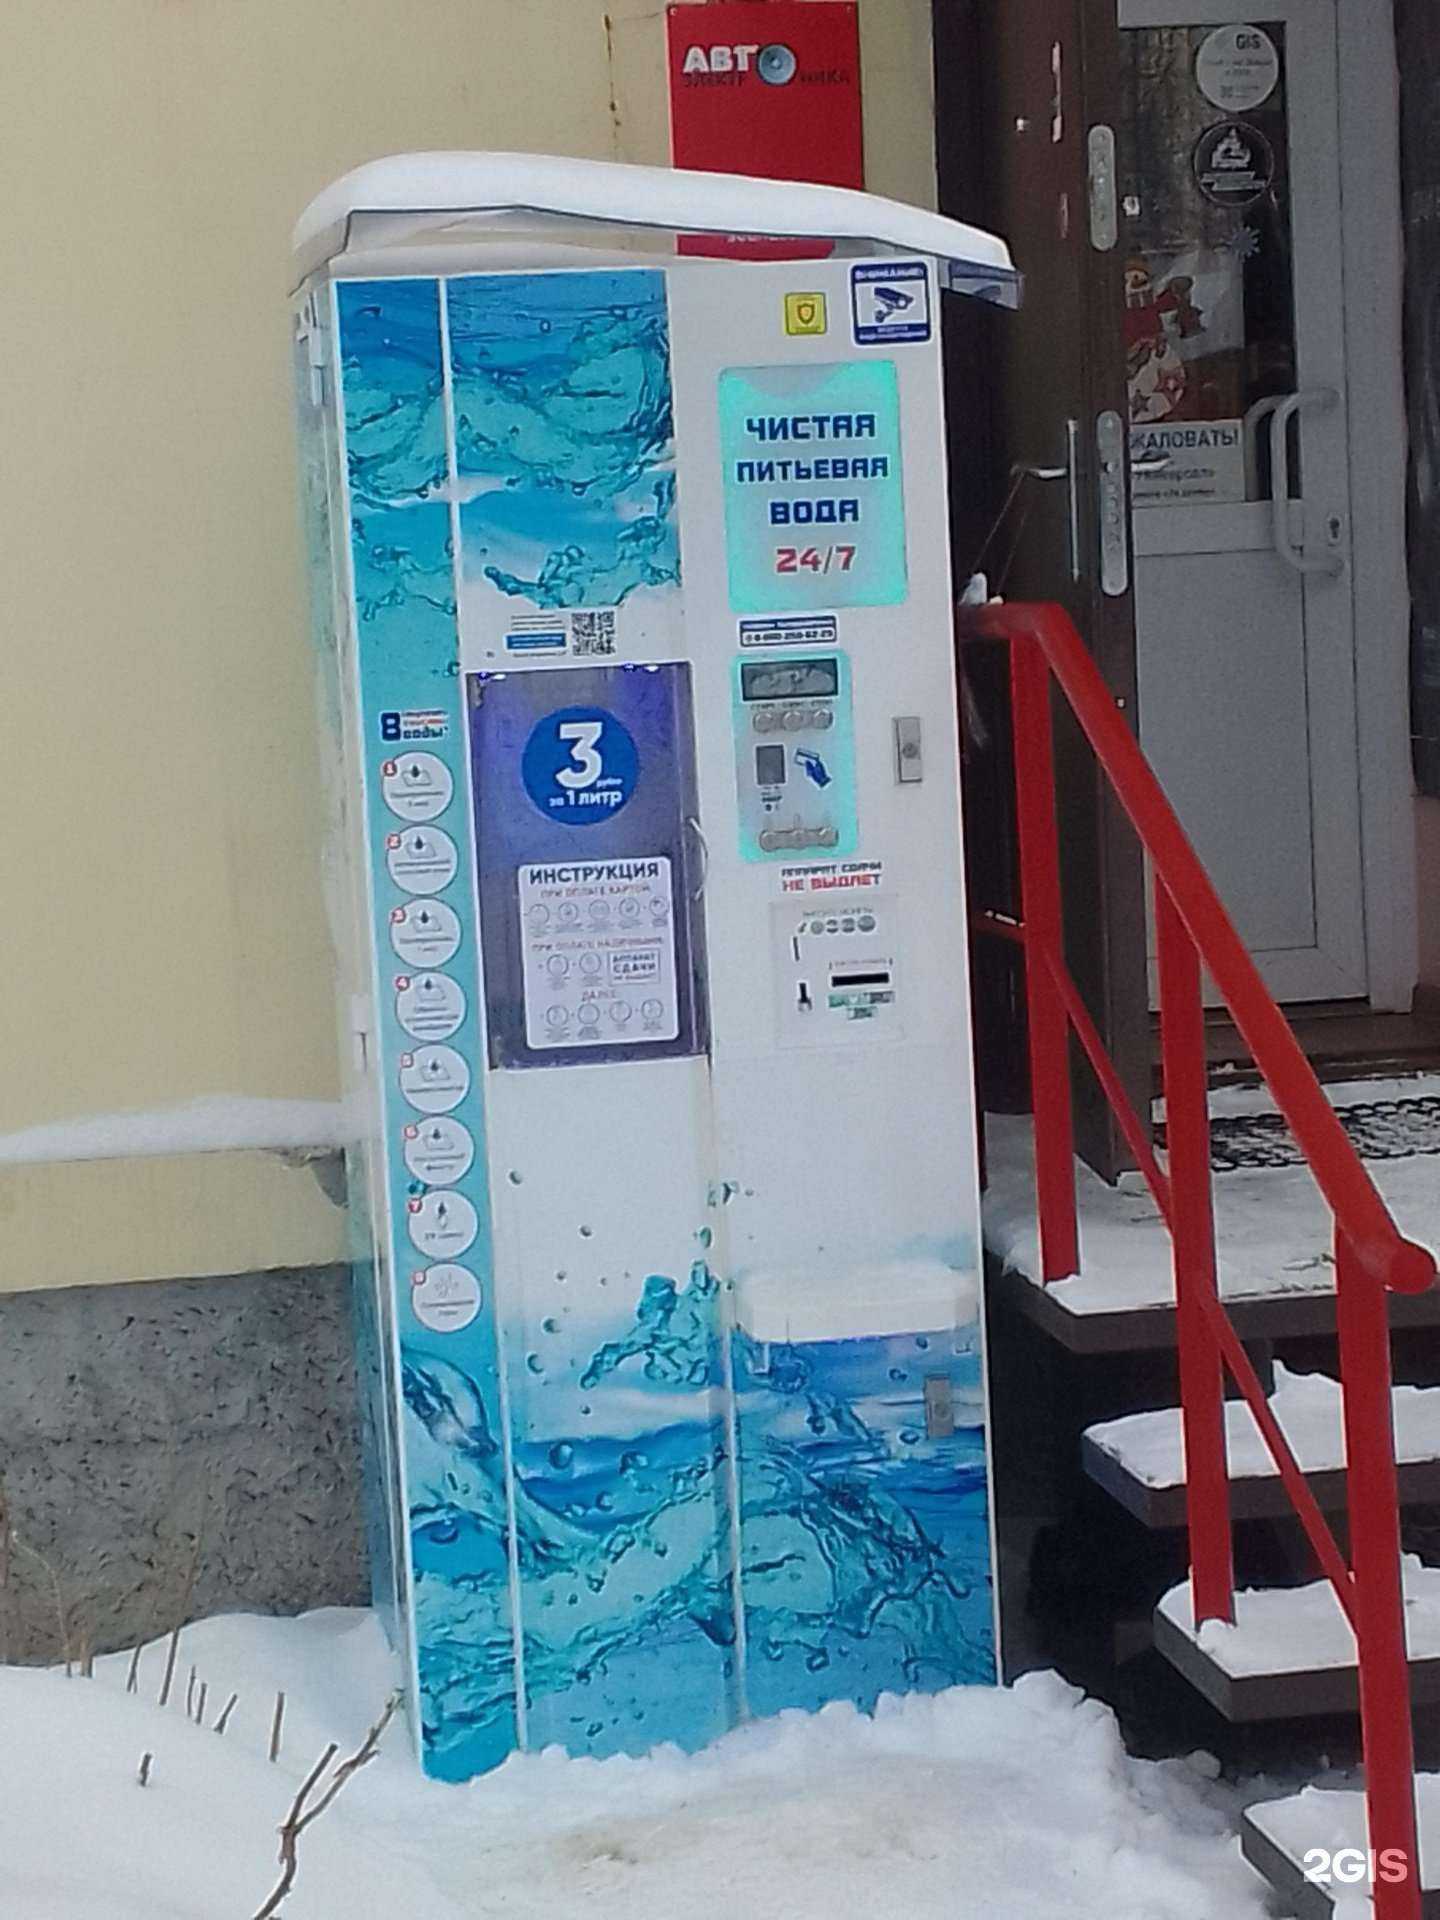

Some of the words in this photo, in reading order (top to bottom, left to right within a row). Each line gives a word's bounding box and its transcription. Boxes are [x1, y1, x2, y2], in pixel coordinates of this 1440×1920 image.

[747, 414, 875, 441] ЧИСТАЯ
[737, 456, 888, 482] ПИТЬЕВАЯ
[770, 499, 859, 525] ВОДА
[776, 545, 856, 574] 24/7
[556, 722, 603, 788] 3
[566, 790, 575, 806] 1
[578, 790, 623, 807] литр
[530, 862, 659, 885] ИНСТРУКЦИЯ
[783, 880, 805, 891] НЕ
